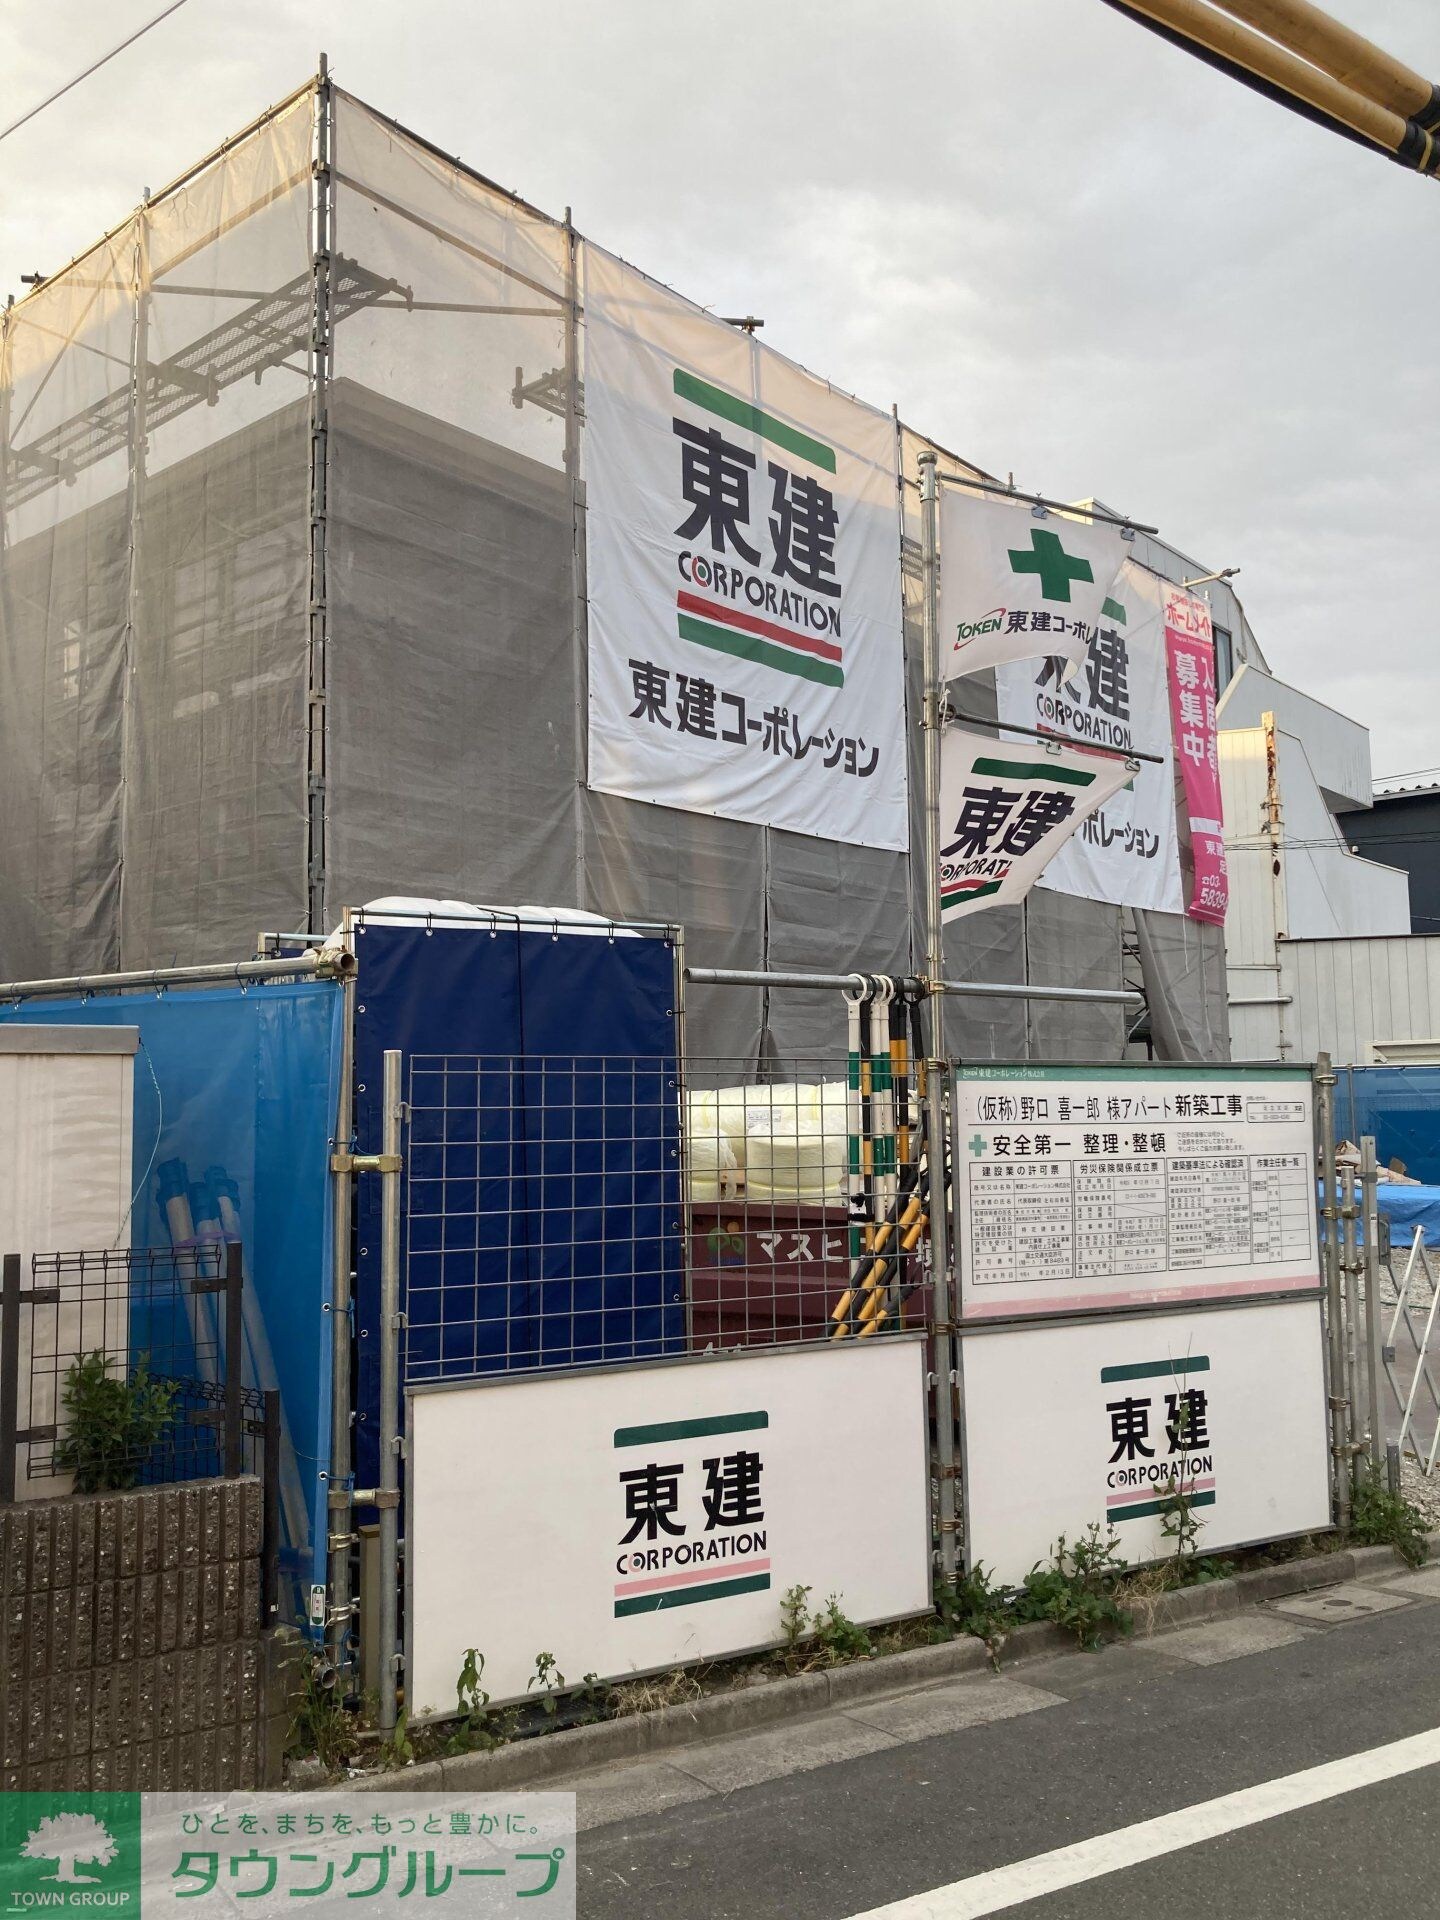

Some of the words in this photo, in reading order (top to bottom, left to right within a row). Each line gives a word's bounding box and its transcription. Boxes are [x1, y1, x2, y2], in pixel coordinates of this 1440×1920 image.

[673, 416, 841, 598] 東建
[678, 550, 841, 637] CORPORATION
[956, 616, 1003, 643] TOKEN
[628, 658, 880, 778] 東建コーポレーション
[1037, 692, 1133, 749] CORPORATION
[1173, 650, 1204, 766] 募集中
[940, 786, 1076, 858] 東建
[1058, 1096, 1100, 1121] 喜一郎
[993, 1134, 1071, 1157] 安全第一
[1083, 1132, 1166, 1155] 整理・整頓
[1172, 1159, 1244, 1170] 建築基準法による確認済
[1257, 1158, 1300, 1167] 作業主任者一覧
[982, 1165, 1059, 1177] 建設業の許可票
[1080, 1162, 1159, 1174] 労災保険関係成立票
[1106, 1389, 1210, 1463] 東建
[1107, 1455, 1213, 1488] CORPORATION
[618, 1451, 764, 1545] 東建
[616, 1530, 767, 1575] CORPORATION
